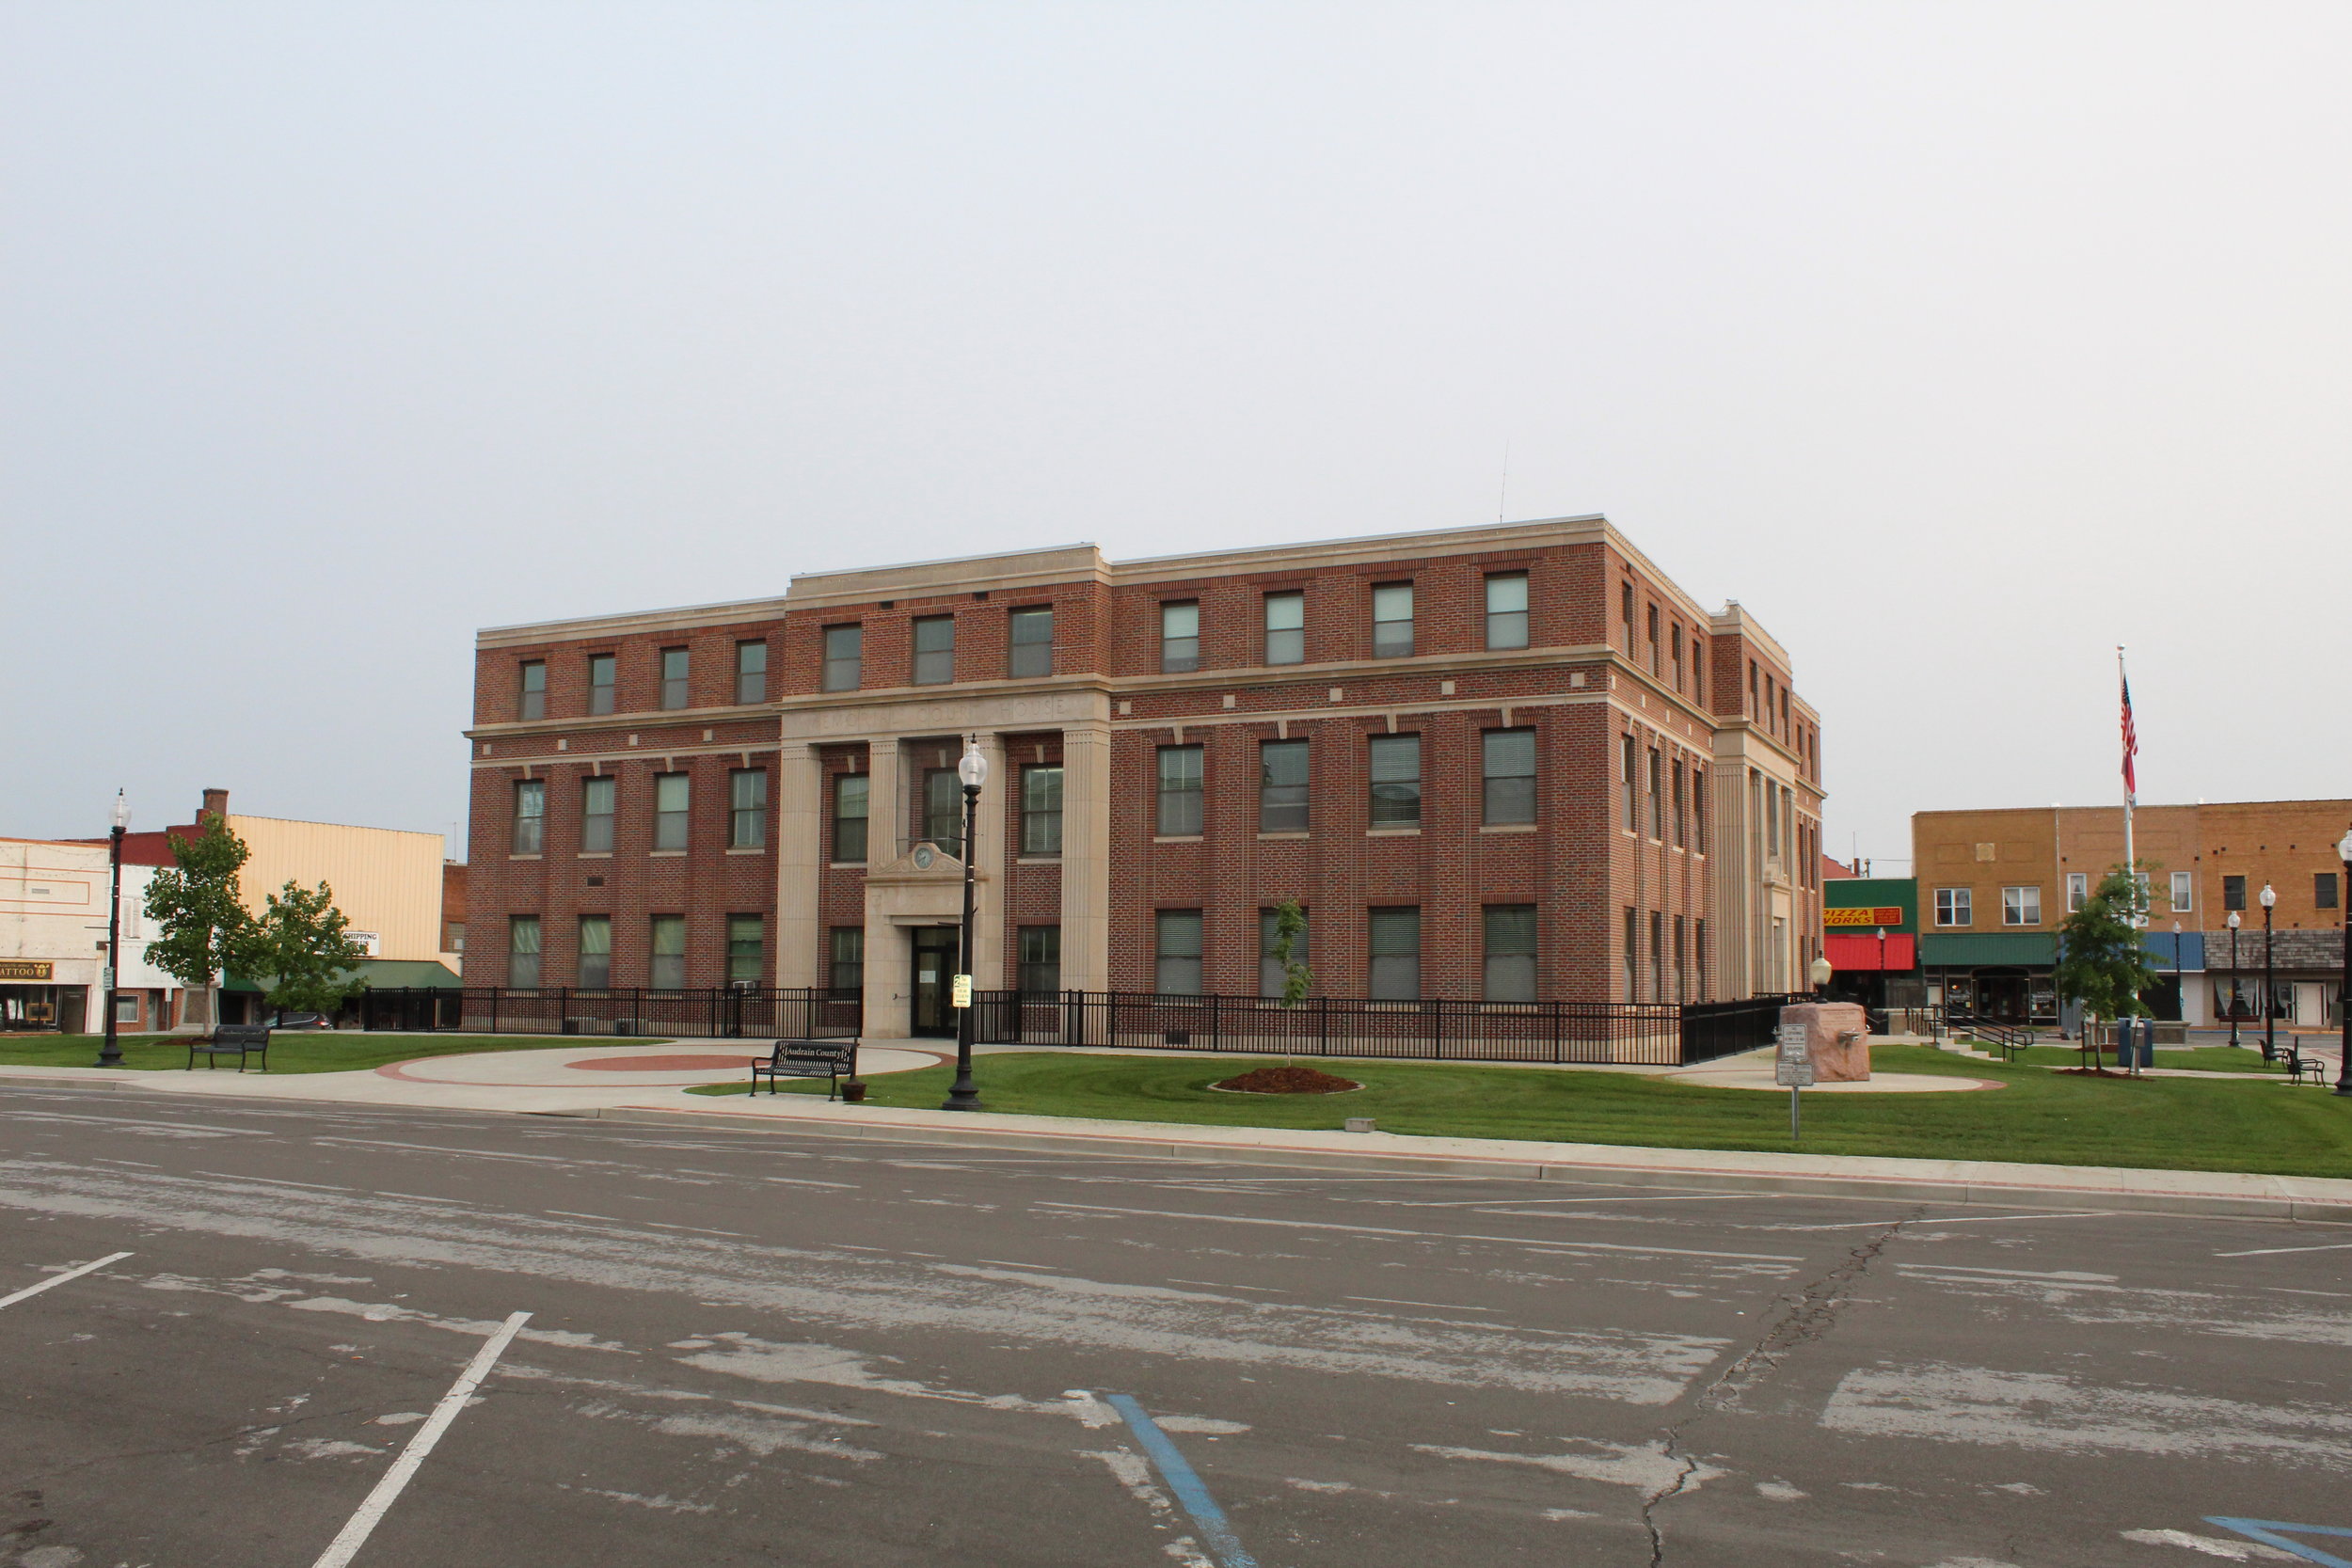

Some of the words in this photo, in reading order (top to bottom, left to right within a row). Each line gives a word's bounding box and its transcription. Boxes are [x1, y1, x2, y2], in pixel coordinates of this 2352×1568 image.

[916, 705, 977, 722] COURT
[1000, 699, 1064, 717] HOUSE
[344, 932, 377, 941] SHIPPING
[787, 1047, 815, 1055] Audrain
[816, 1049, 842, 1059] County
